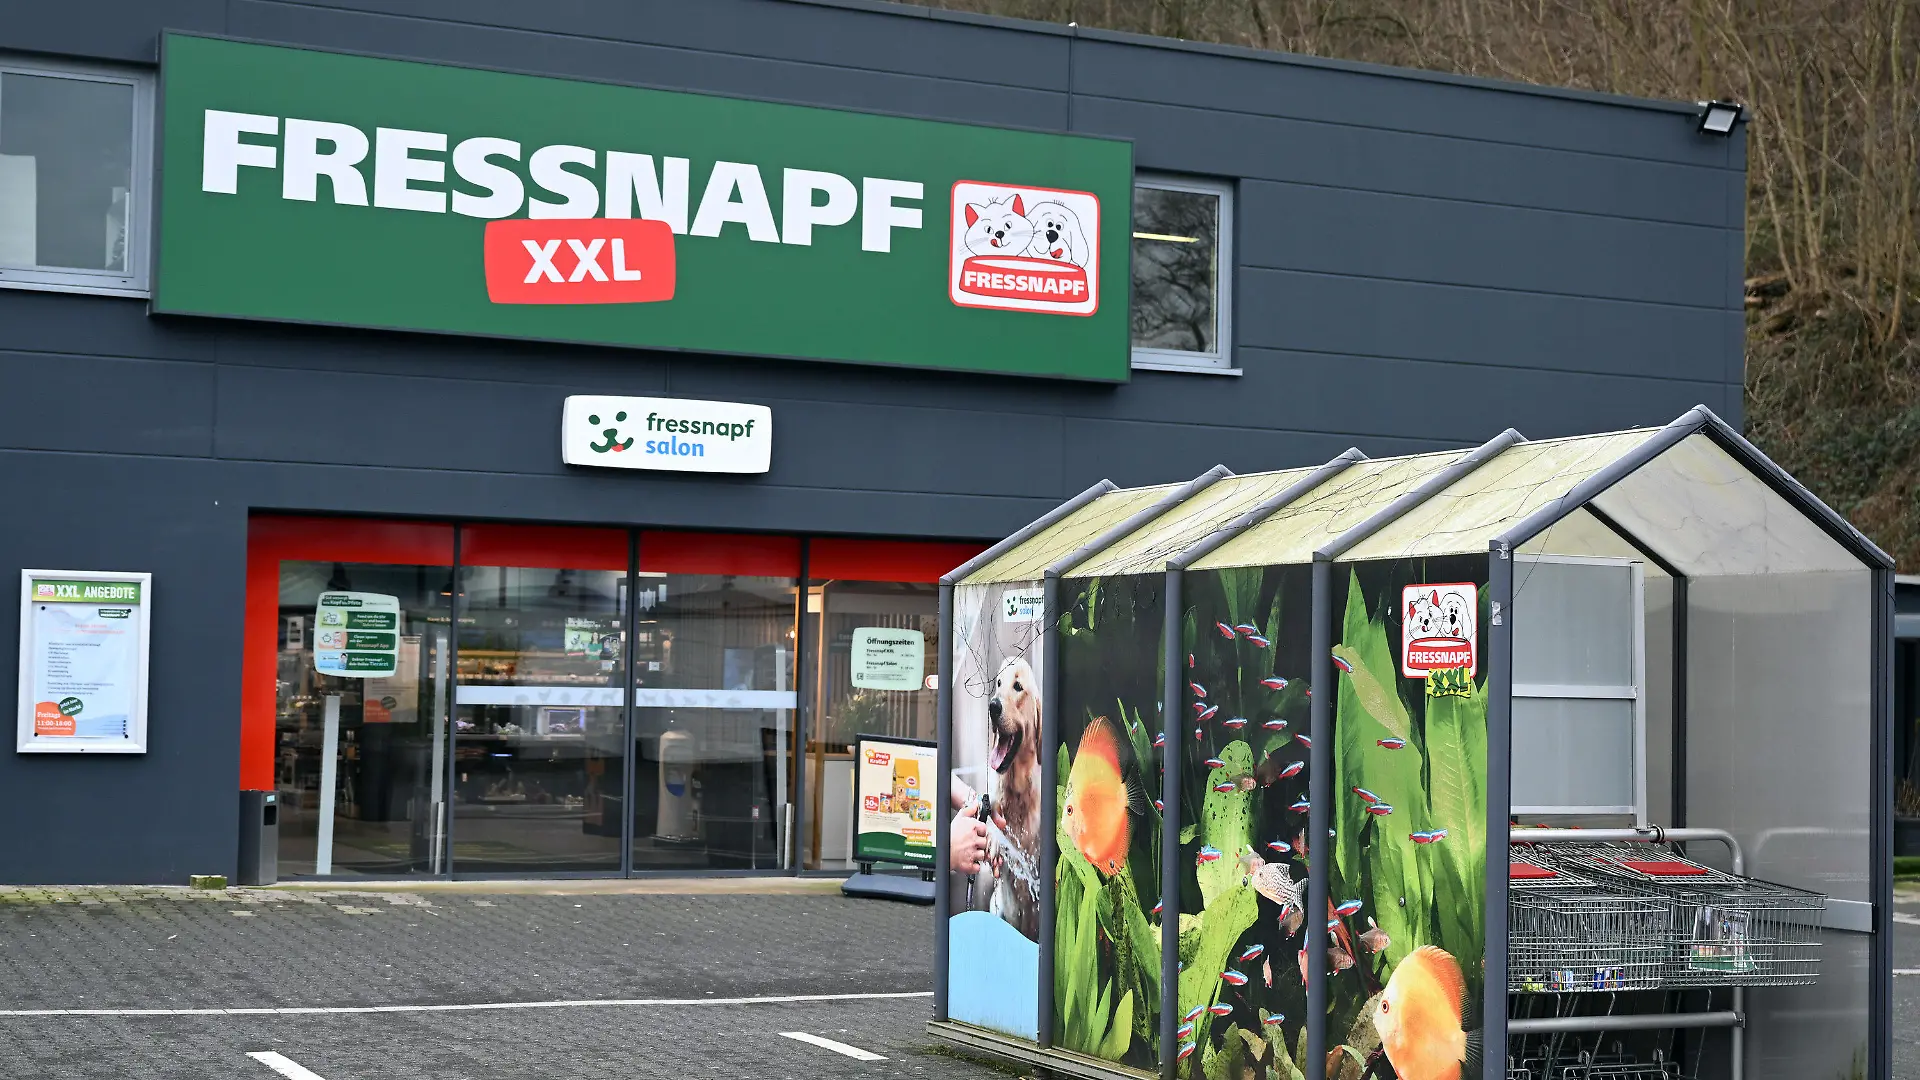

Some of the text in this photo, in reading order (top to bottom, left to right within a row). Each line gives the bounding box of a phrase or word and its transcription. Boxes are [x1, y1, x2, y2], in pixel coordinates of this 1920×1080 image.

[201, 109, 924, 253] FRESSNAPF
[522, 238, 641, 284] XXL
[964, 271, 1085, 296] FRESSNAPF
[646, 412, 755, 441] fressnapf
[645, 435, 704, 457] salon
[56, 584, 135, 599] XXL ANGEBOTE
[866, 636, 914, 646] Öffnungszeiten
[1409, 652, 1470, 664] FRESSNAPF
[1432, 666, 1468, 696] XXL
